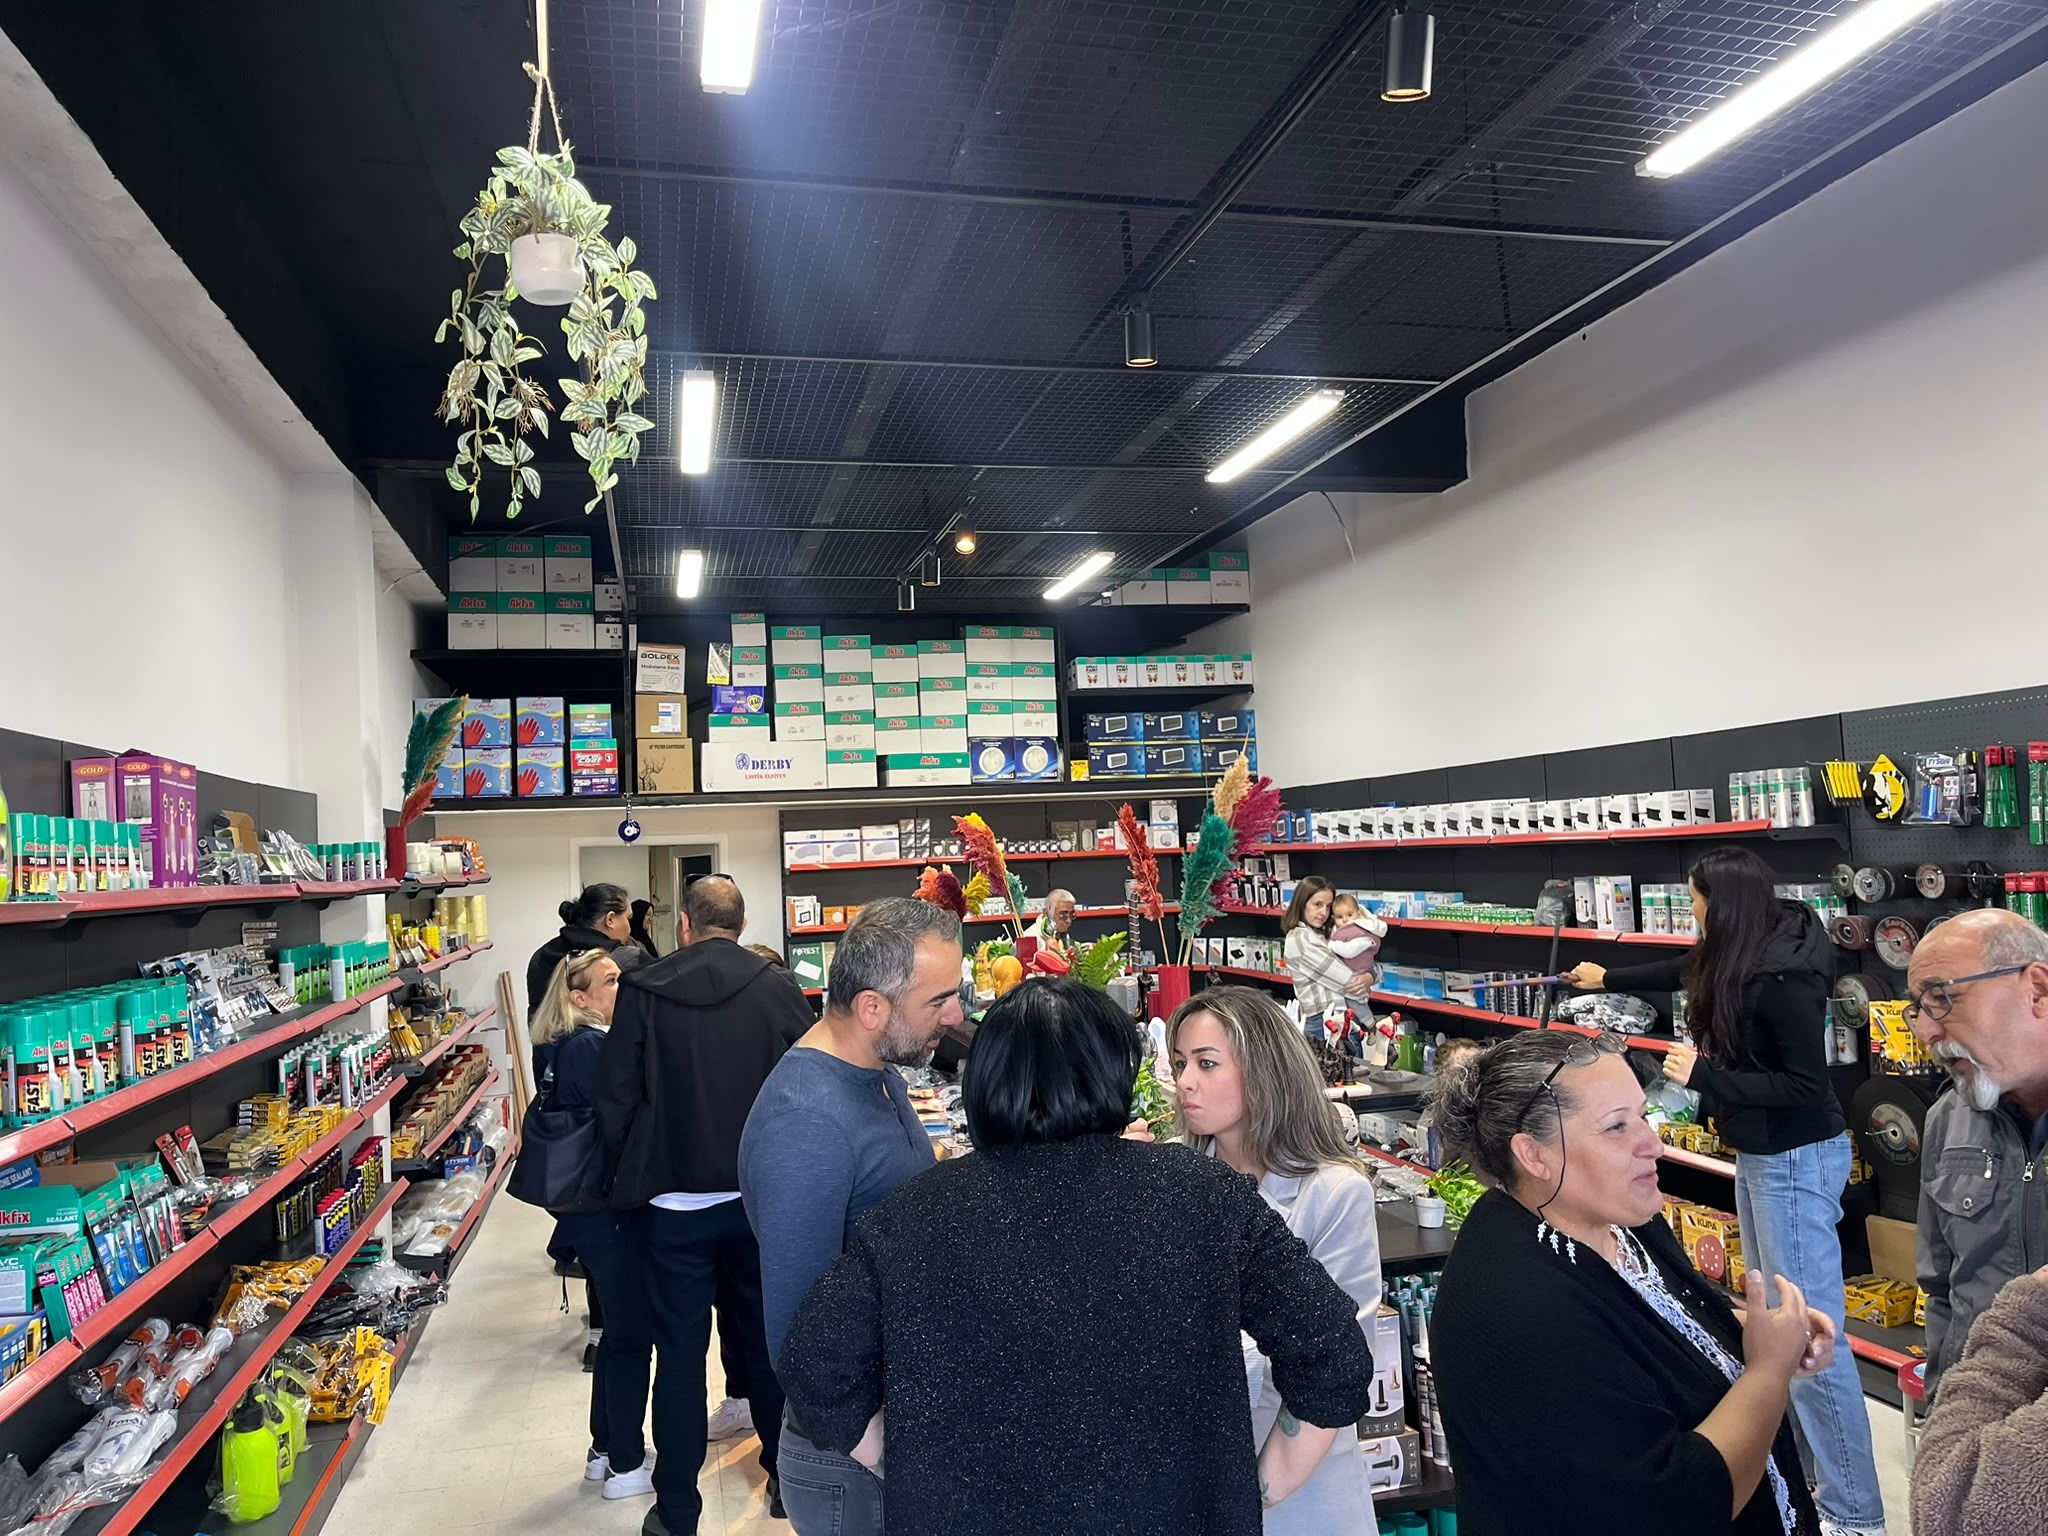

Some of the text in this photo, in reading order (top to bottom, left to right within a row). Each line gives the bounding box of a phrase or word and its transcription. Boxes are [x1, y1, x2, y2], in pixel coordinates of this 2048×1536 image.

[459, 597, 487, 609] Akfix
[508, 597, 536, 609] Akfix
[556, 598, 582, 609] Akfix
[786, 629, 806, 637] Akfix
[788, 668, 808, 676] Akfix
[531, 701, 547, 709] derby
[788, 704, 809, 713] Akfix
[888, 719, 908, 728] Akfix
[751, 759, 793, 770] DERBY
[80, 767, 104, 775] GOLD
[792, 947, 820, 956] FOREST
[173, 1036, 183, 1063] FAST
[156, 1041, 166, 1069] FAST
[143, 1047, 153, 1077] FAST
[37, 1064, 48, 1073] 705
[27, 1080, 40, 1114] FAST
[10, 1167, 33, 1182] SEALANT
[0, 1209, 30, 1225] kfix
[46, 1215, 78, 1223] SEALANT
[1697, 1218, 1718, 1231] KUPA
[0, 1258, 18, 1266] VC
[38, 1273, 56, 1282] PVC
[1846, 1289, 1865, 1299] KUPA
